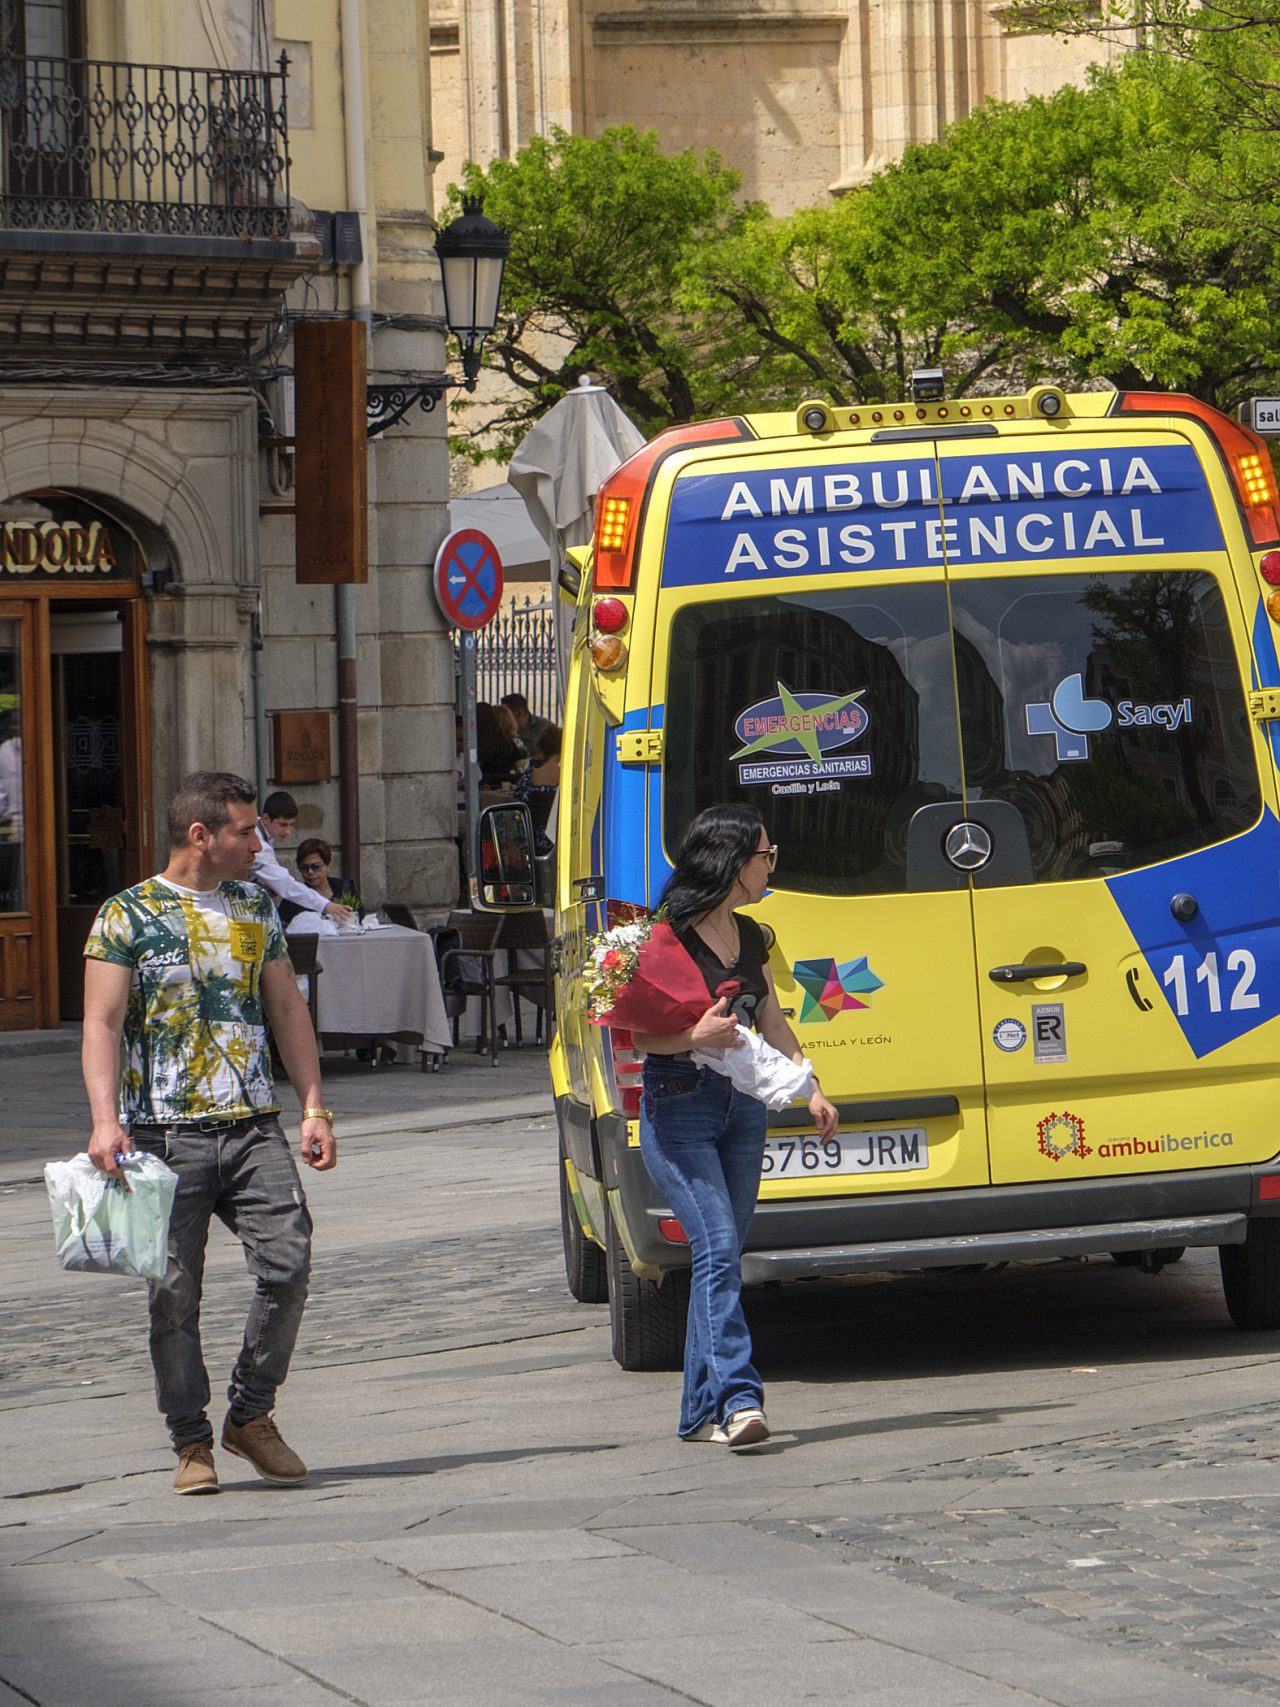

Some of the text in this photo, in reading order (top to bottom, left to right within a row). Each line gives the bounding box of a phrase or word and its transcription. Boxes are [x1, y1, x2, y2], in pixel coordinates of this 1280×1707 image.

[720, 457, 1162, 521] AMBULANCIA
[0, 521, 117, 573] NDORA
[724, 509, 1165, 573] ASISTENCIAL
[743, 710, 862, 737] EMERGENCIAS
[1117, 698, 1192, 730] Sacyl
[743, 760, 867, 780] EMERGENCIAS SANITARIAS
[772, 780, 841, 795] Castilla y León
[1163, 949, 1261, 1016] 112
[800, 1033, 892, 1050] ASTILLA Y LEÓN
[761, 1133, 920, 1173] 5769 JRM
[1097, 1131, 1234, 1158] ambuiberica
